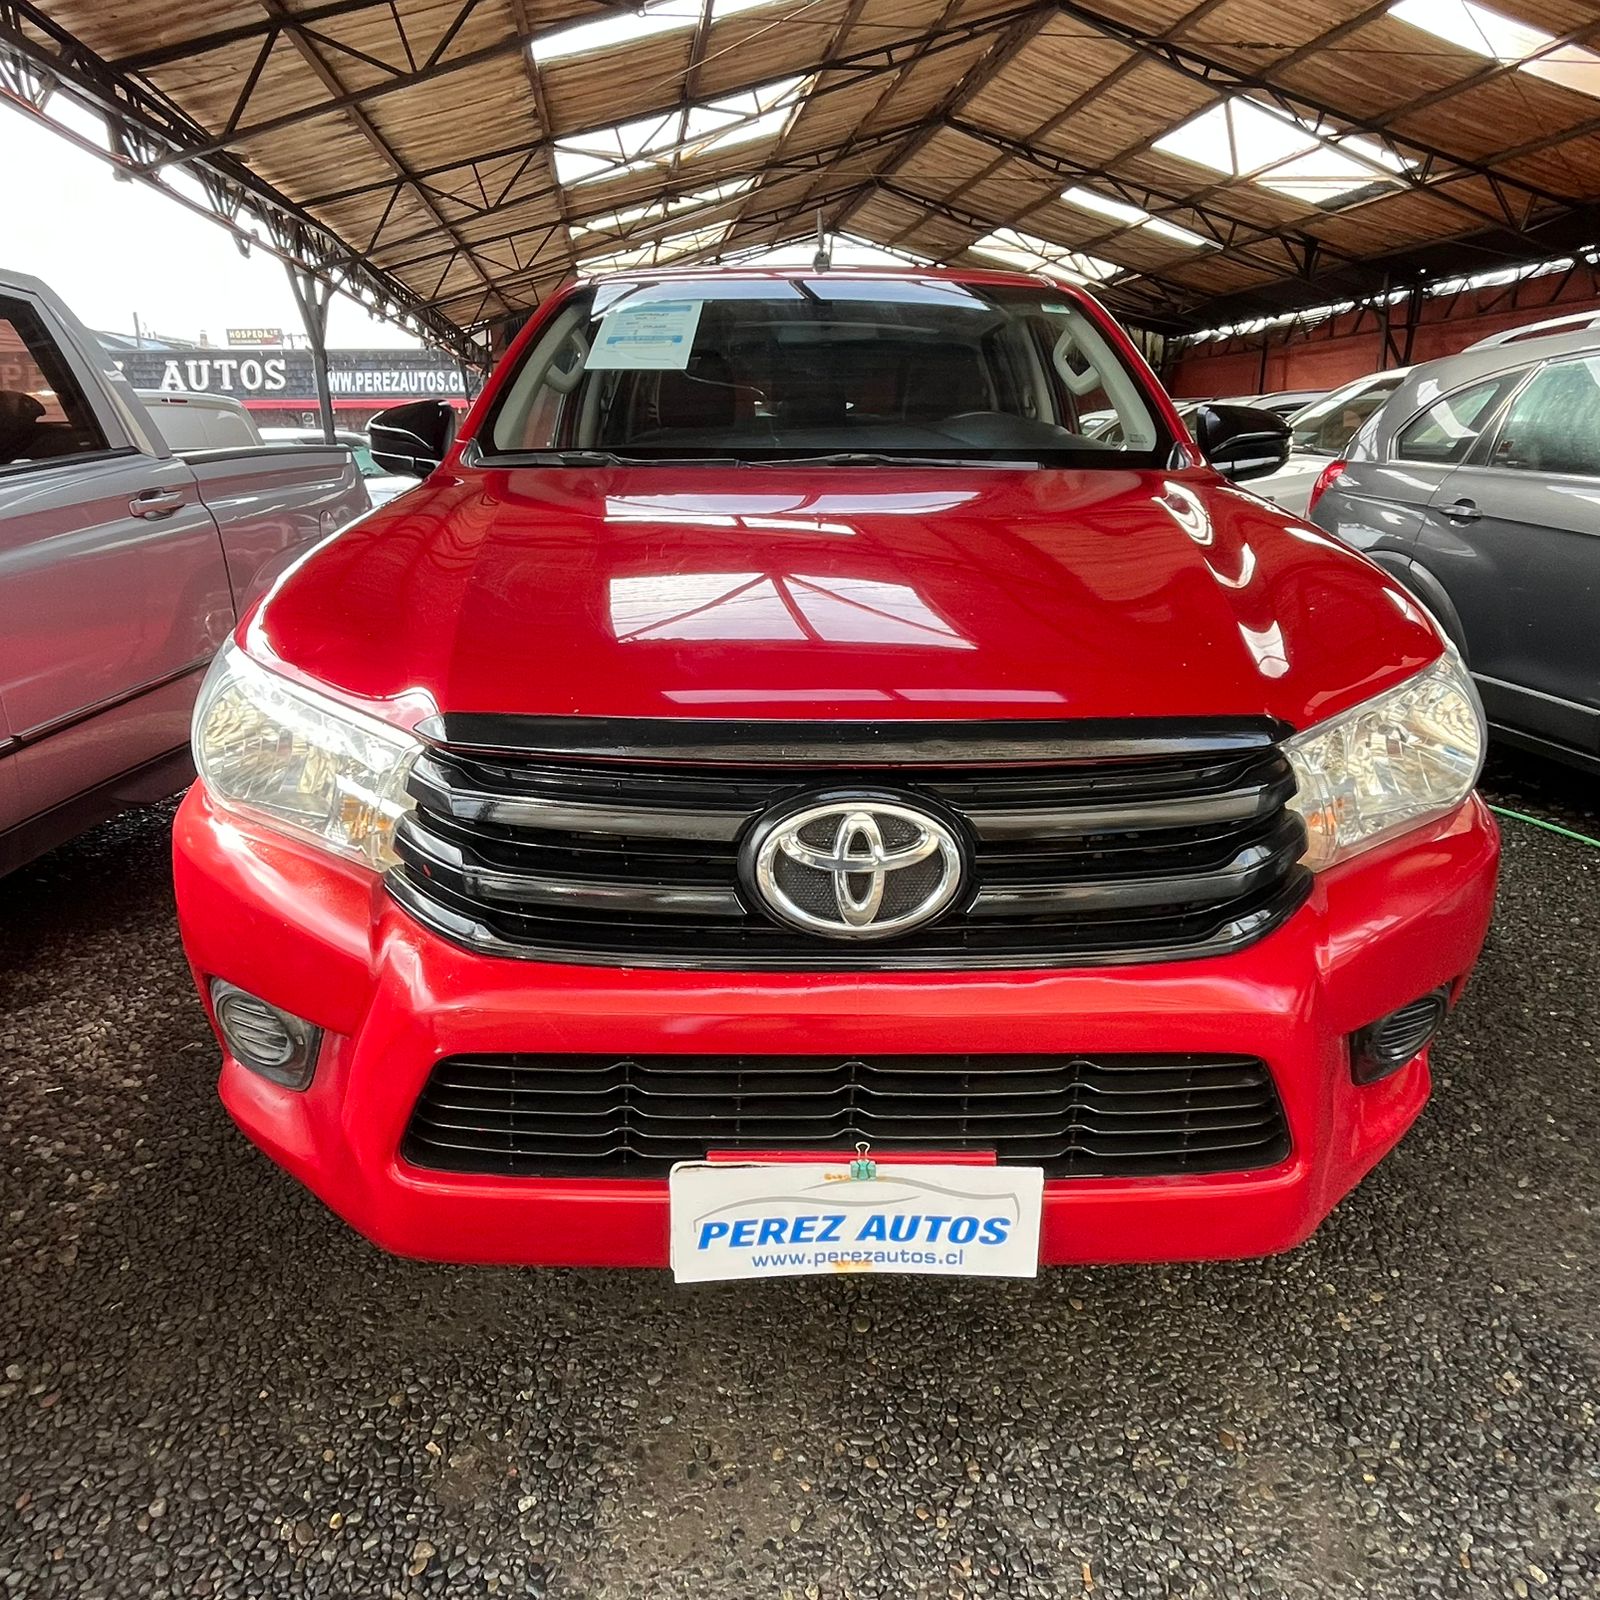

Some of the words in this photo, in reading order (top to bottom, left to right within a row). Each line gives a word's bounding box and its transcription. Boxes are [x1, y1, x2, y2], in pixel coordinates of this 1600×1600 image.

[159, 359, 286, 391] AUTOS
[328, 370, 466, 393] WW.PEREZAUTOS.CL
[698, 1215, 847, 1250] PEREZ
[854, 1215, 1011, 1245] AUTOS
[752, 1249, 964, 1268] www.perezautos.cl
